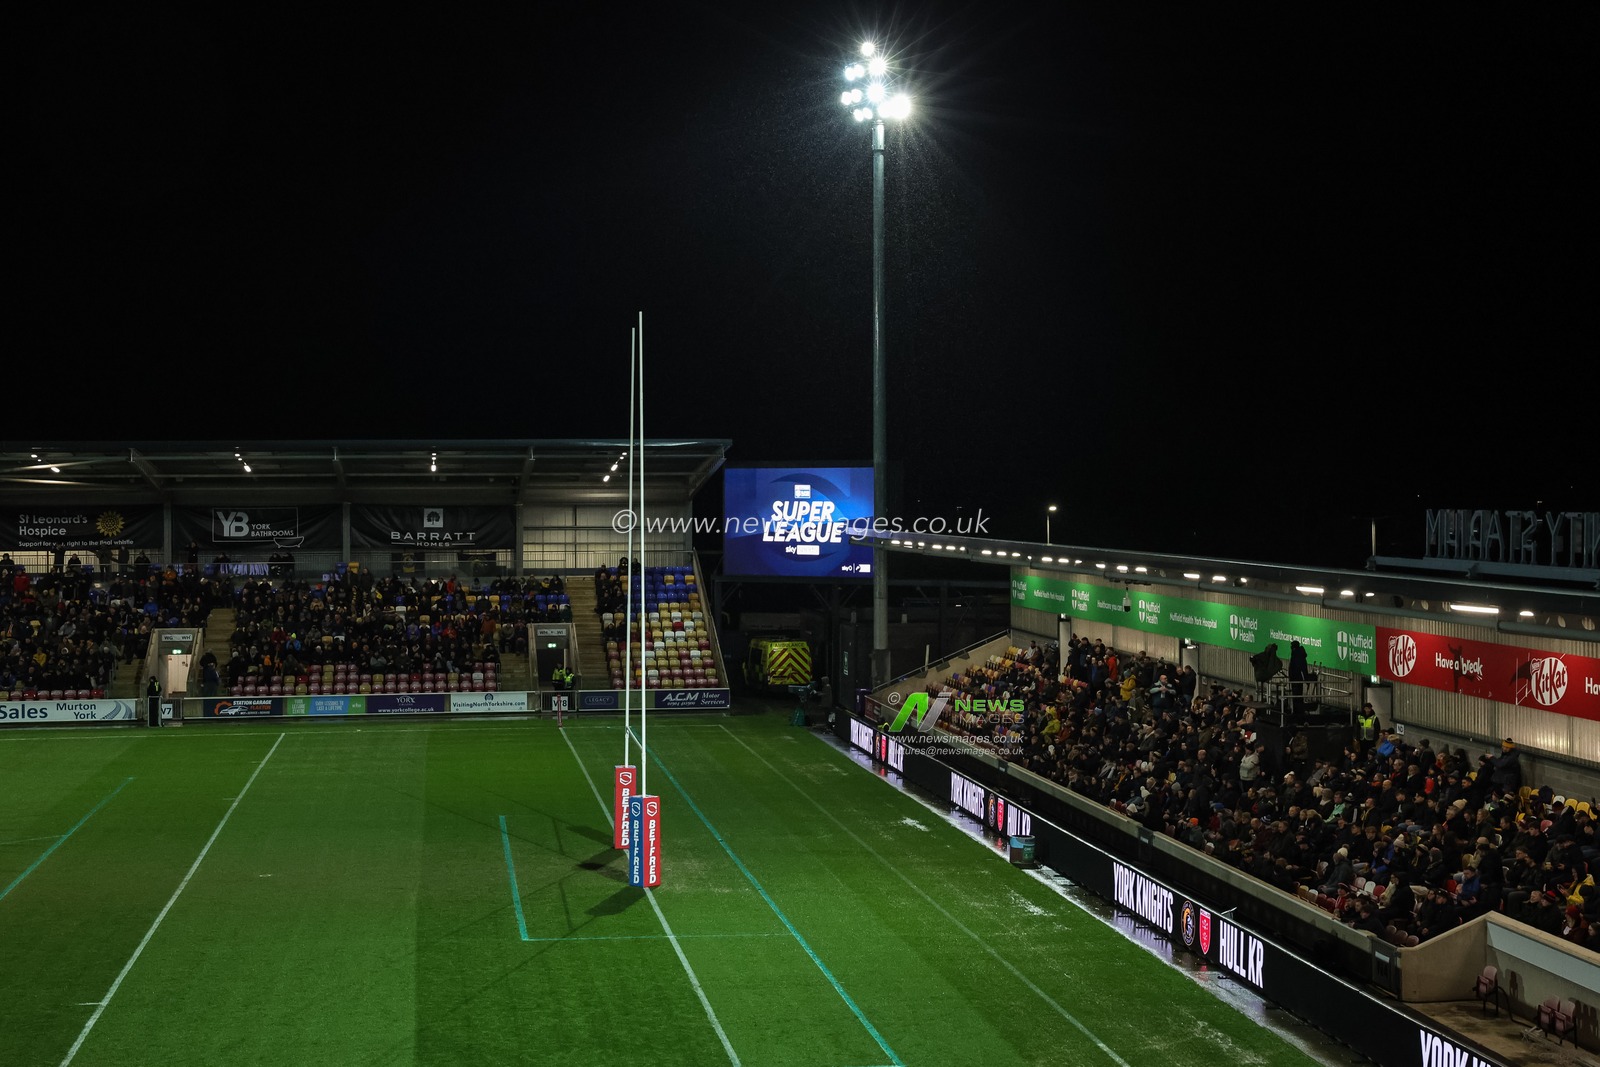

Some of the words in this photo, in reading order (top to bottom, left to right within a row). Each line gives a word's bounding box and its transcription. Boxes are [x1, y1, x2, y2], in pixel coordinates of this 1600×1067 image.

[771, 500, 835, 522] SUPER
[19, 514, 30, 524] St
[32, 514, 88, 524] Leonard's
[216, 511, 250, 537] YB
[19, 526, 67, 538] Hospice
[390, 531, 476, 541] BARRATT
[763, 522, 845, 543] LEAGUE
[66, 540, 81, 548] right
[1145, 601, 1161, 613] Nuffield
[1145, 612, 1159, 624] Health
[1239, 616, 1258, 630] Nuffield
[1239, 629, 1255, 643] Health
[1270, 629, 1292, 642] Healthcare
[1302, 636, 1310, 645] can
[1310, 637, 1322, 647] trust
[1349, 633, 1373, 649] Nuffield
[1349, 647, 1369, 664] Health
[1390, 635, 1416, 677] KitKat
[1435, 652, 1454, 670] Have
[1454, 660, 1460, 671] a
[1460, 656, 1484, 676] break
[1533, 658, 1567, 706] KitKat
[1585, 676, 1600, 696] Ha
[56, 702, 97, 711] Murton
[452, 701, 526, 709] VisitingNorthYorkshire.com
[700, 698, 725, 706] Services
[0, 704, 48, 719] Sales
[73, 711, 97, 720] York
[621, 788, 630, 846] BETFRED
[1113, 862, 1136, 911] YORK
[1136, 874, 1174, 934] KNIGHTS
[1219, 920, 1247, 978] HULL
[1247, 935, 1264, 989] KR
